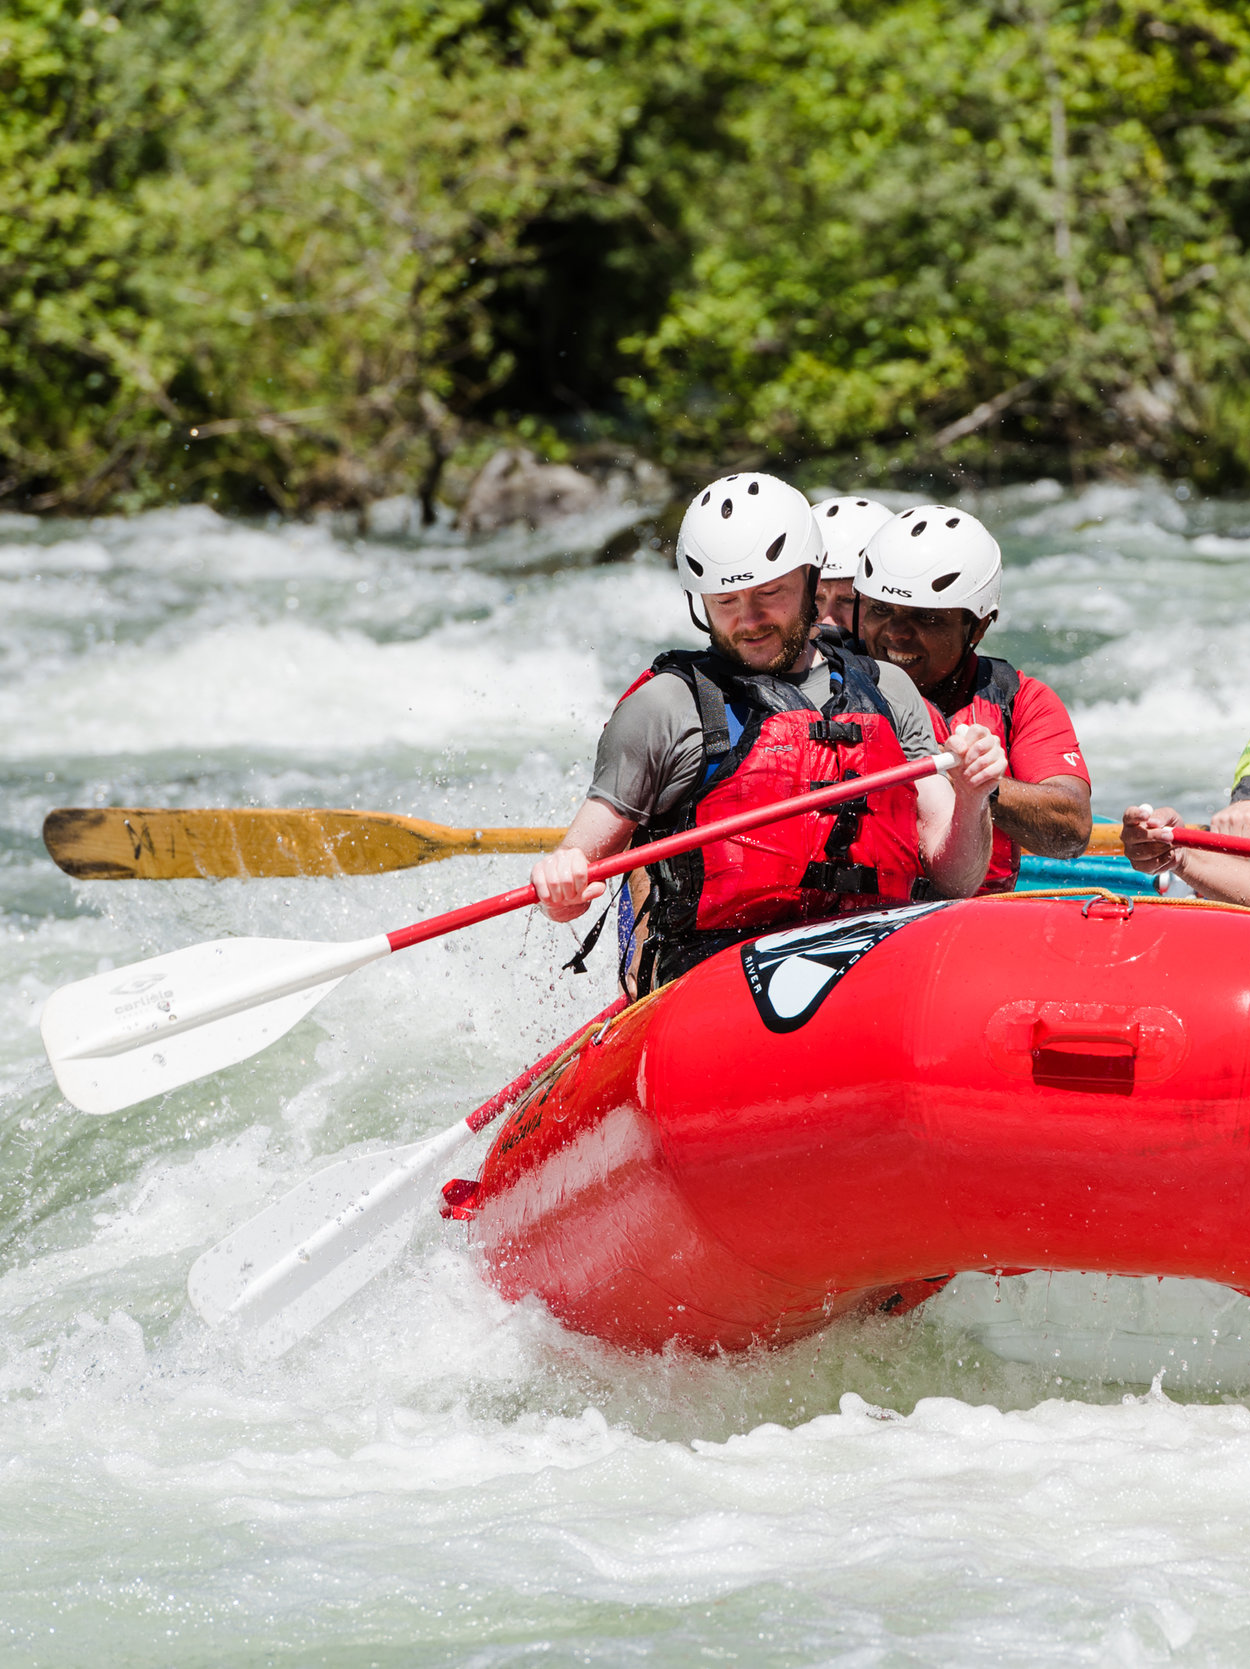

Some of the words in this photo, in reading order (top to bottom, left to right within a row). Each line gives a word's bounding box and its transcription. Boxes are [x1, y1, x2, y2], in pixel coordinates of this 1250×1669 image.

[720, 571, 755, 586] NRS
[881, 585, 912, 598] NRS
[764, 744, 793, 753] NRS
[744, 954, 763, 995] RIVER
